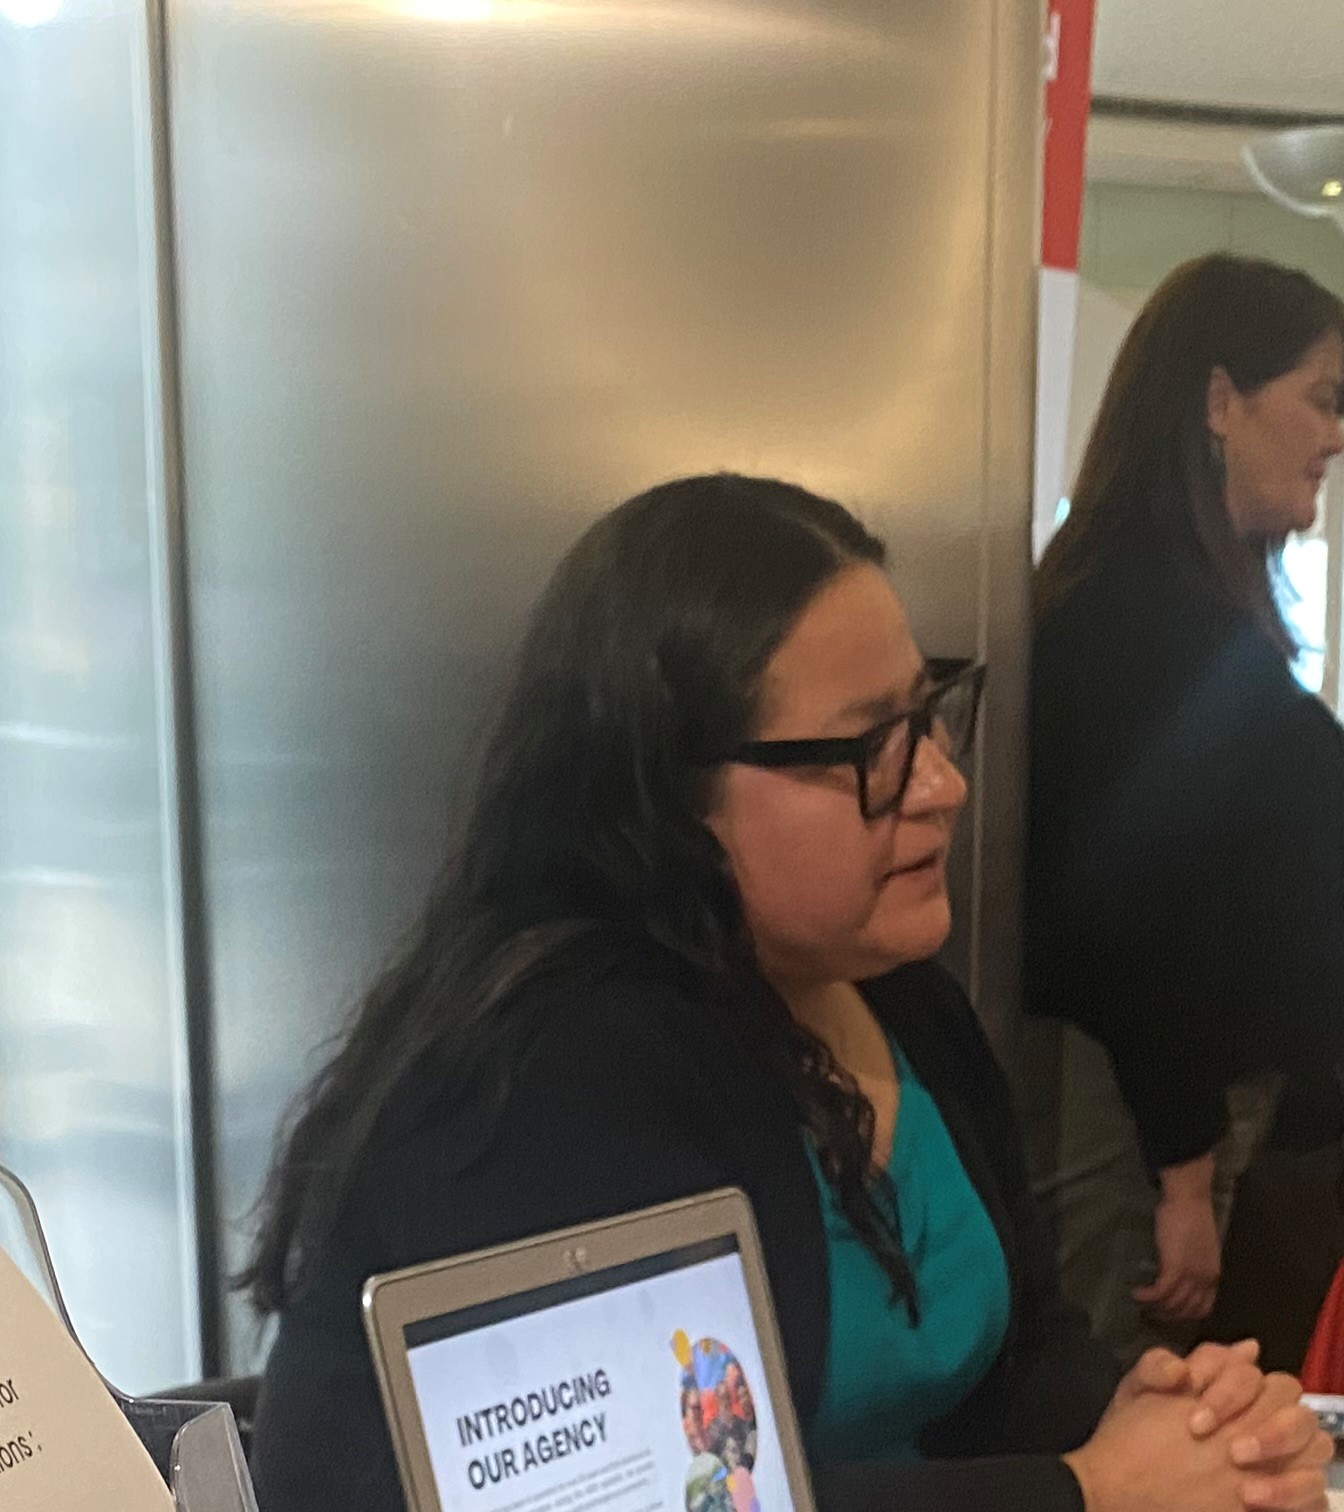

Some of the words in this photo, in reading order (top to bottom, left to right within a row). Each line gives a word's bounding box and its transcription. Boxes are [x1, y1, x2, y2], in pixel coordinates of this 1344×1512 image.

[456, 1368, 613, 1447] INTRODUCING
[467, 1454, 519, 1491] OUR
[524, 1413, 608, 1472] AGENCY
